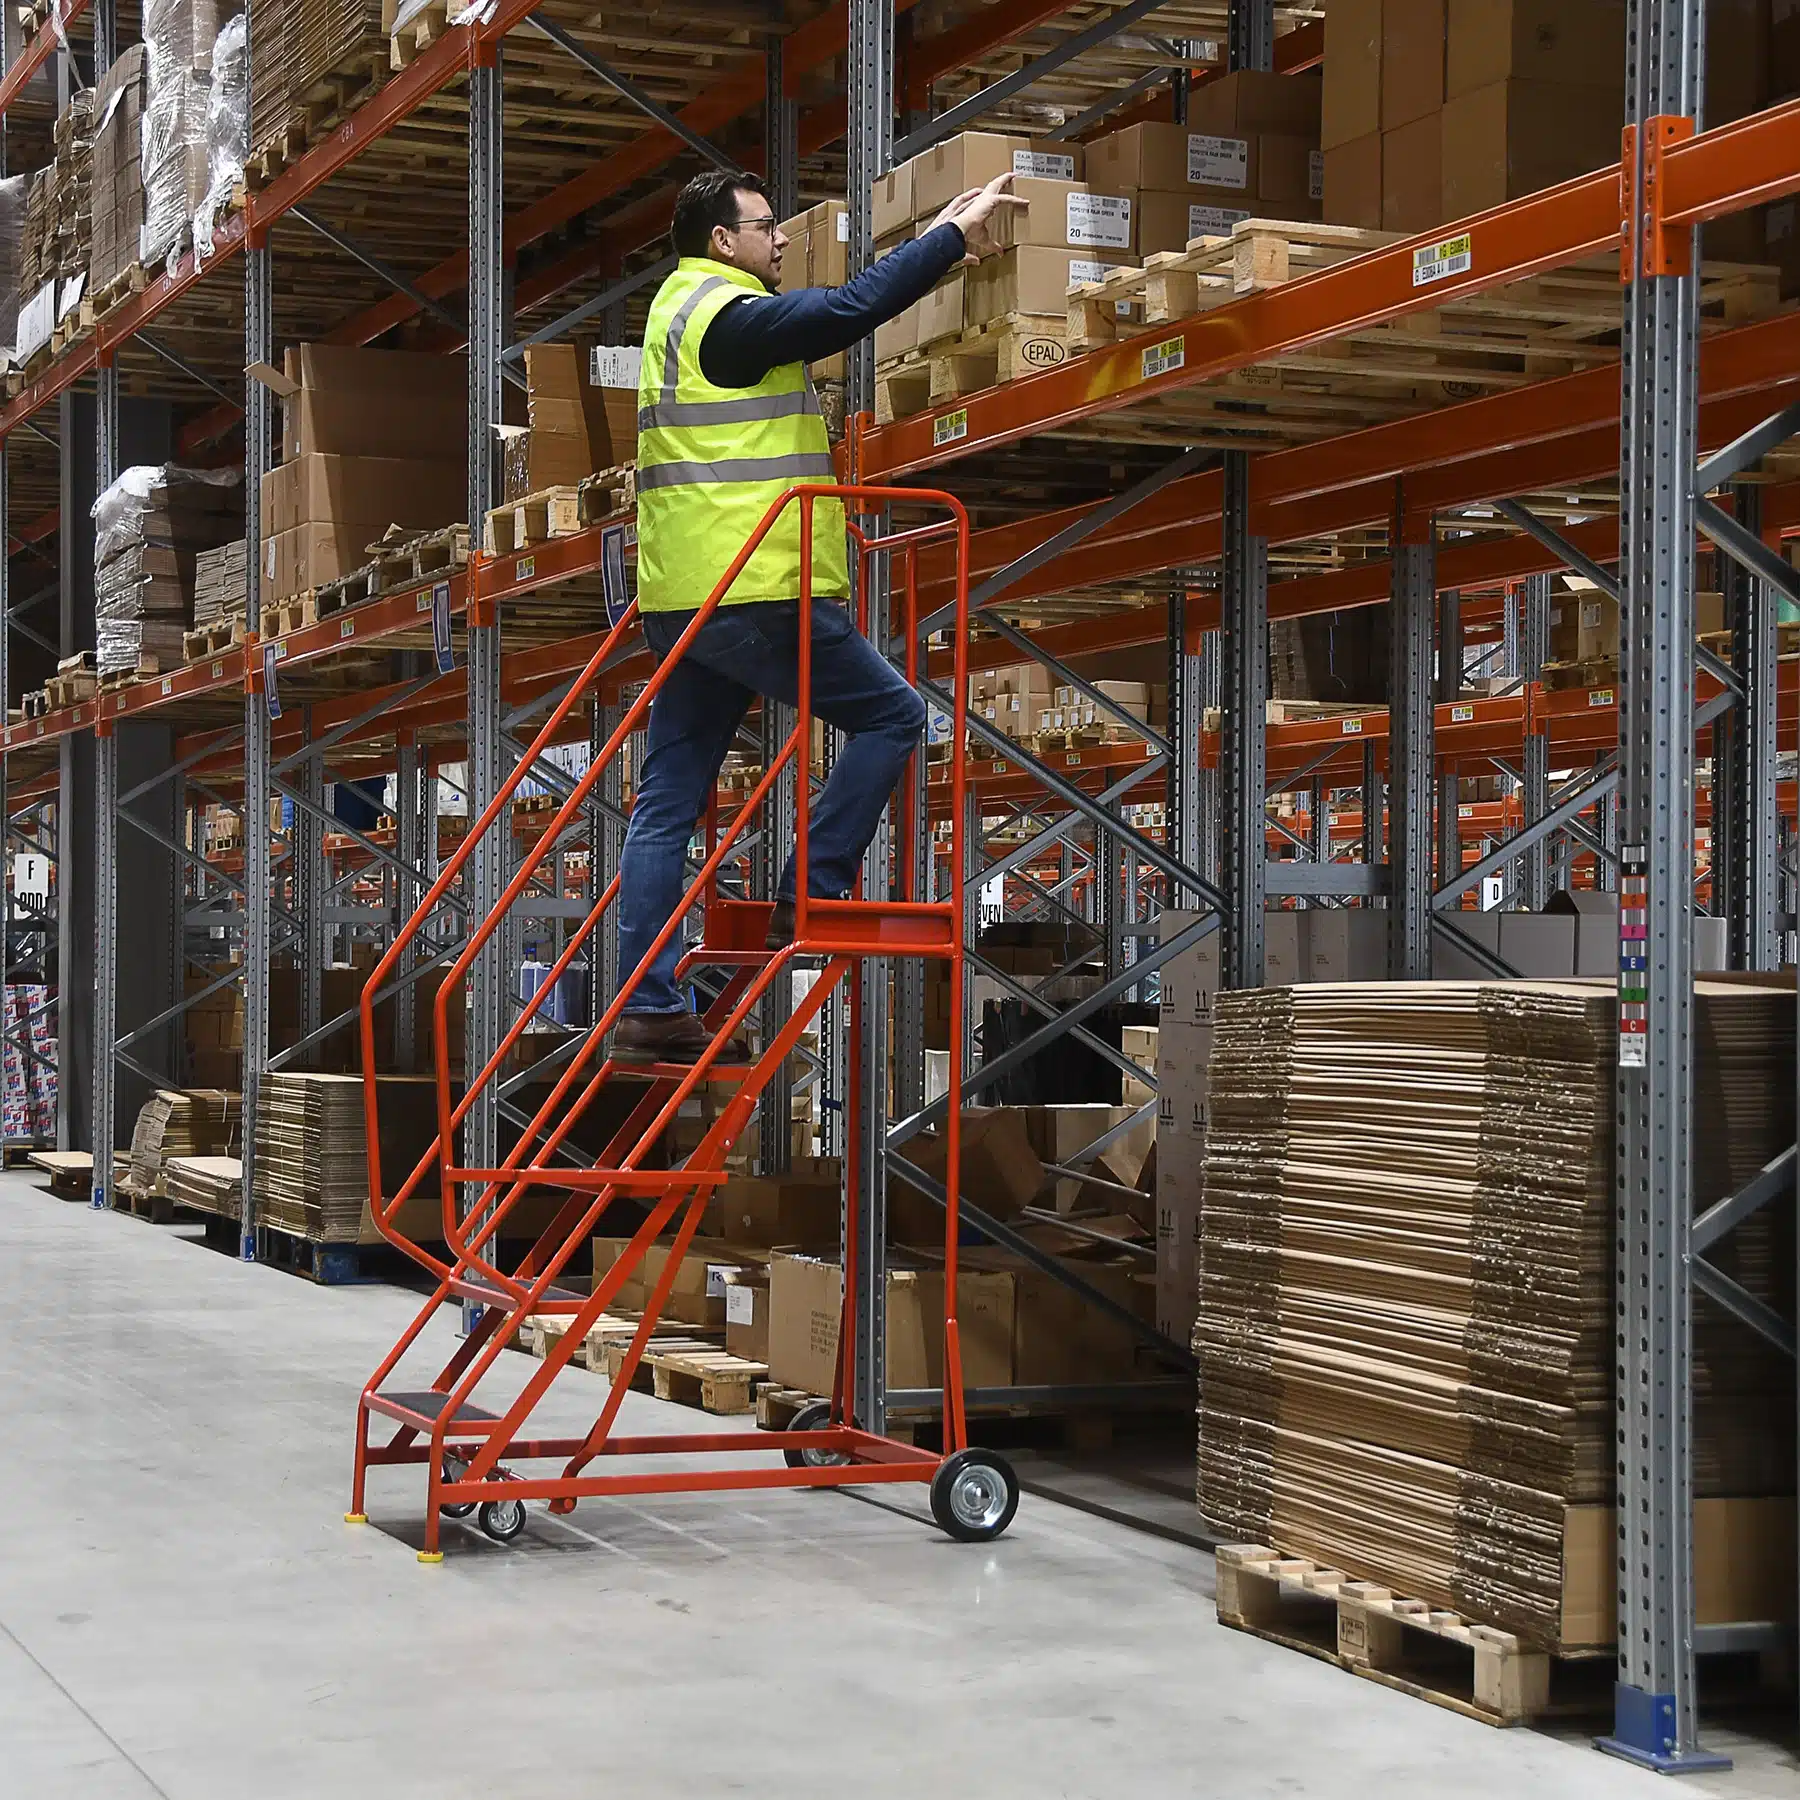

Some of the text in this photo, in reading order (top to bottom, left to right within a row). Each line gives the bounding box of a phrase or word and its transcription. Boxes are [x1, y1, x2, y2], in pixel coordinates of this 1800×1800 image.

[1190, 170, 1201, 180] 20
[1312, 186, 1322, 196] 20
[1070, 228, 1081, 238] 20
[1029, 344, 1058, 362] EPAL
[28, 860, 35, 880] F
[1630, 864, 1637, 874] H
[1493, 884, 1499, 900] D
[982, 904, 1001, 925] VEN
[1631, 926, 1636, 936] F
[1630, 958, 1636, 969] E
[1630, 1020, 1636, 1032] C
